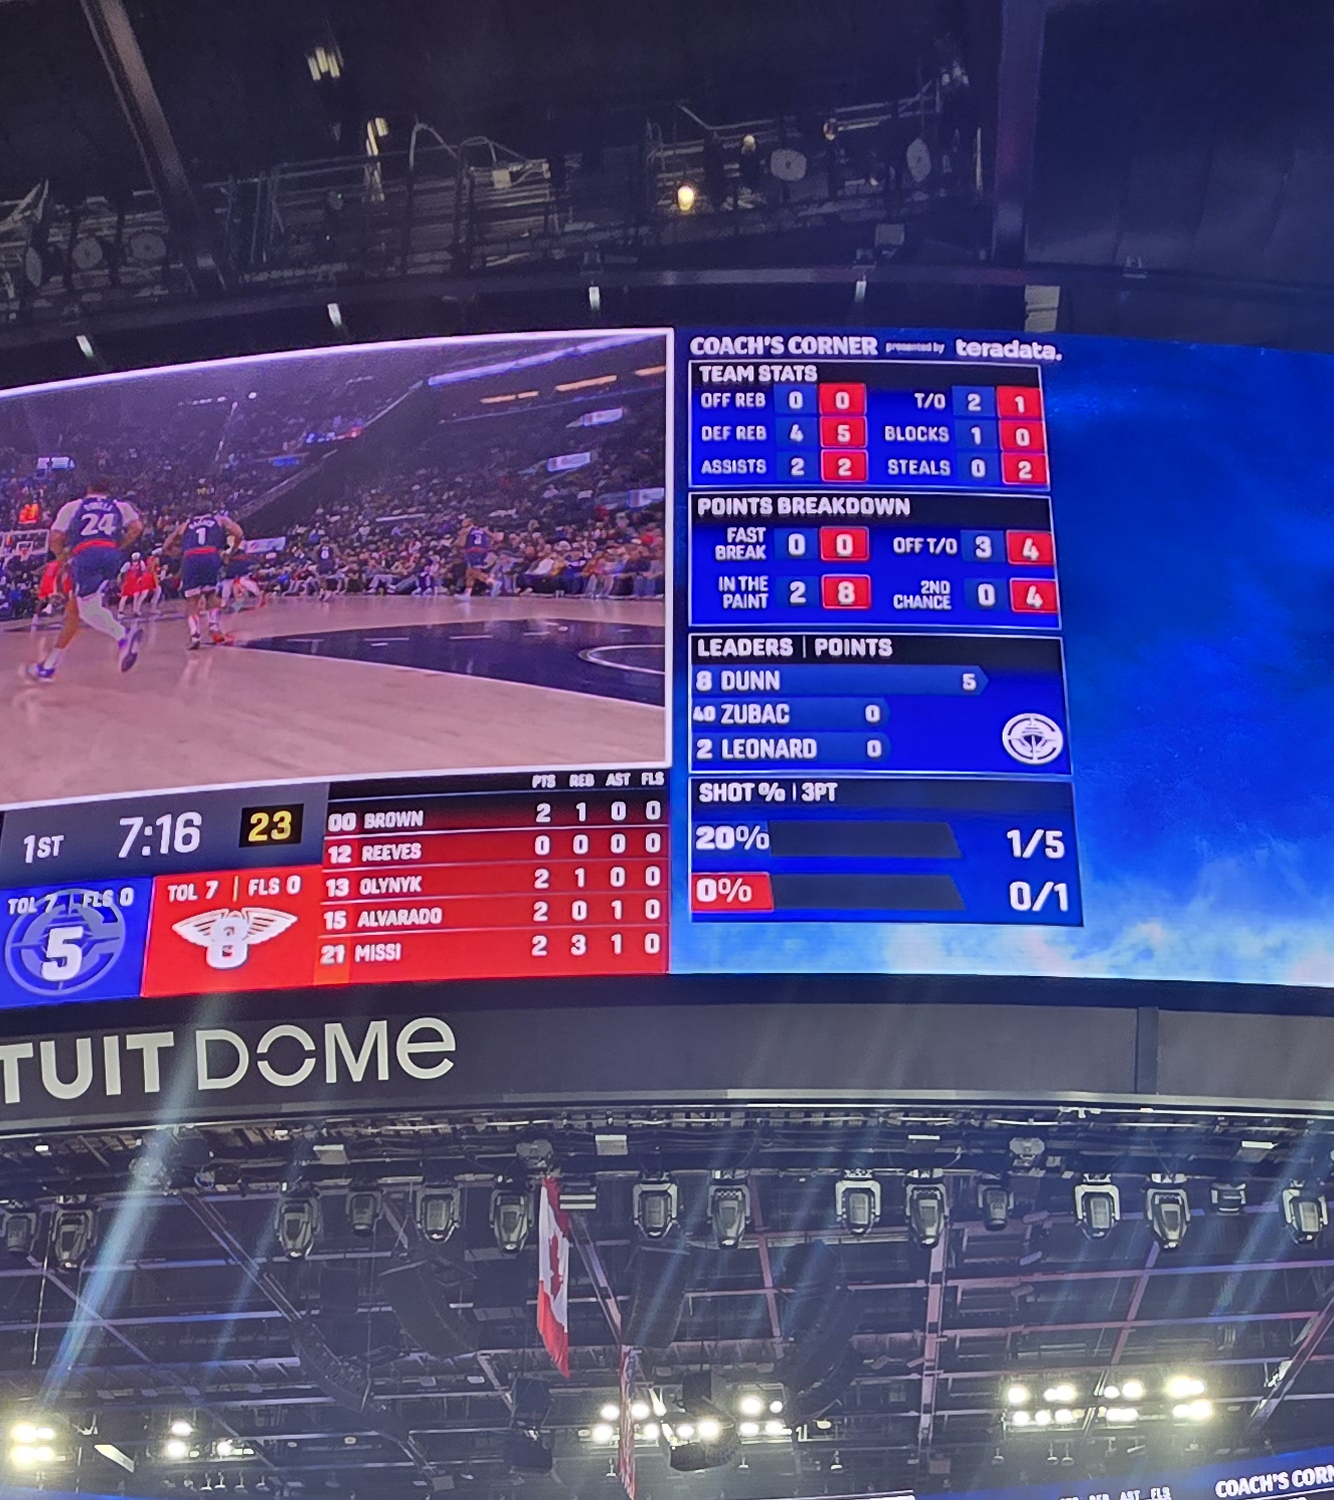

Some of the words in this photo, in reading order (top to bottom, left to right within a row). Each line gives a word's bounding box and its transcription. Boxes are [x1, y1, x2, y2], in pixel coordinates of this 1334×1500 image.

[690, 337, 784, 355] COACH'S
[788, 337, 877, 355] CORNER
[886, 342, 924, 353] presented
[927, 342, 945, 354] by
[700, 365, 755, 382] TEAM
[758, 365, 817, 382] STATS
[701, 393, 731, 407] OFF
[735, 392, 766, 407] REB
[915, 393, 946, 409] T/O
[701, 426, 732, 441] DEF
[736, 426, 766, 441] REB
[885, 426, 948, 442] BLOCKS
[701, 459, 767, 475] ASSISTS
[888, 459, 951, 475] STEALS
[698, 498, 773, 516] POINTS
[778, 498, 910, 516] BREAKDOWN
[81, 513, 115, 536] 24
[727, 527, 766, 543] FAST
[715, 545, 766, 560] BREAK
[893, 537, 924, 554] OFF
[927, 537, 957, 554] T/O
[719, 576, 736, 591] IN
[740, 576, 768, 591] THE
[921, 580, 951, 595] 2ND
[723, 593, 768, 609] PAINT
[893, 594, 951, 610] CHANCE
[698, 638, 793, 657] LEADERS
[815, 638, 892, 657] POINTS
[696, 671, 712, 691] 8
[721, 671, 780, 690] DUNN
[962, 673, 977, 690] 5
[693, 706, 715, 722] 40
[721, 704, 790, 725] ZUBAC
[865, 705, 880, 722] 0
[697, 739, 712, 759] 2
[721, 738, 817, 759] LEONARD
[867, 740, 882, 758] 0
[532, 774, 555, 788] PTS
[570, 773, 594, 787] REB
[606, 772, 630, 785] AST
[641, 771, 663, 785] FLS
[699, 783, 754, 802] SHOT
[758, 783, 786, 802] %
[802, 783, 837, 801] 3PT
[328, 813, 355, 831] 00
[365, 811, 424, 829] BROWN
[24, 835, 64, 864] 1ST
[119, 811, 204, 859] 7:16
[249, 812, 291, 841] 23
[696, 826, 770, 850] 20%
[1007, 829, 1065, 859] 1/5
[328, 846, 351, 863] 12
[362, 843, 421, 862] REEVES
[168, 883, 198, 902] TOL
[204, 881, 218, 898] 7
[248, 877, 279, 896] FLS
[287, 875, 300, 894] 0
[326, 879, 349, 896] 13
[359, 876, 422, 895] OLYNYK
[697, 879, 752, 902] 0%
[1009, 882, 1067, 912] 0/1
[8, 897, 36, 915] TOL
[45, 894, 56, 911] 7
[83, 891, 112, 908] FLS
[119, 888, 133, 906] 0
[323, 911, 346, 929] 15
[357, 907, 442, 927] ALVARADO
[206, 916, 248, 969] 8
[41, 927, 83, 982] 5
[320, 945, 345, 963] 21
[354, 944, 401, 962] MISSI
[196, 1018, 456, 1090] DOME
[1215, 1470, 1289, 1498] COACH'S
